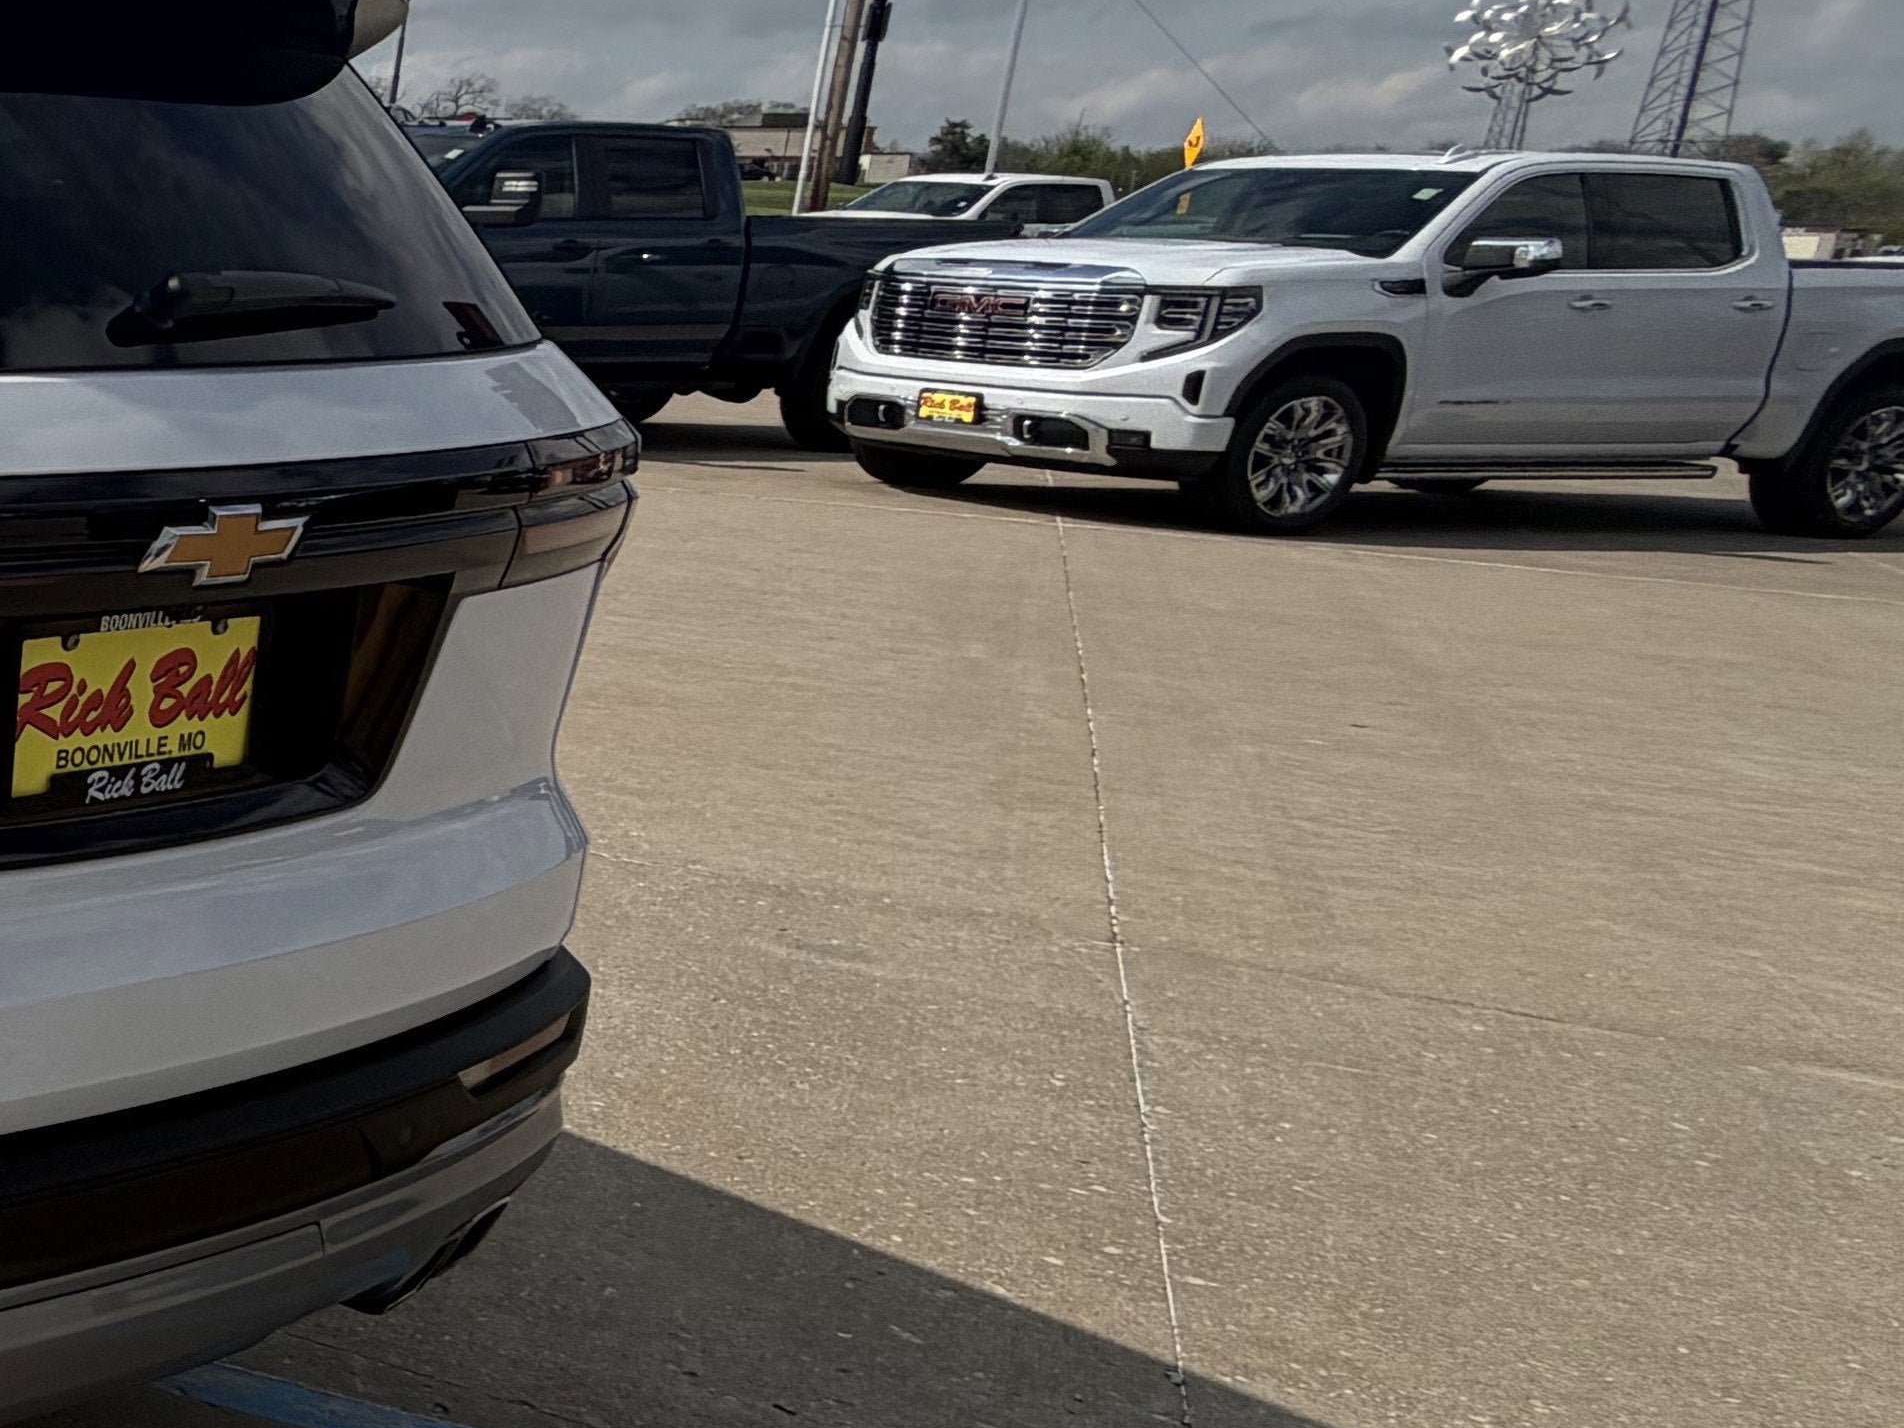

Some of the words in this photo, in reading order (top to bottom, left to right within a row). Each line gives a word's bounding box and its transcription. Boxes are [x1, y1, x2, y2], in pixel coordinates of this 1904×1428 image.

[932, 293, 1027, 316] GMC
[15, 657, 137, 742] Rick
[148, 647, 257, 729] Ball
[55, 735, 173, 770] BOONVILLE,
[178, 730, 206, 753] MO
[85, 767, 135, 805] Rick
[139, 762, 187, 795] Ball
